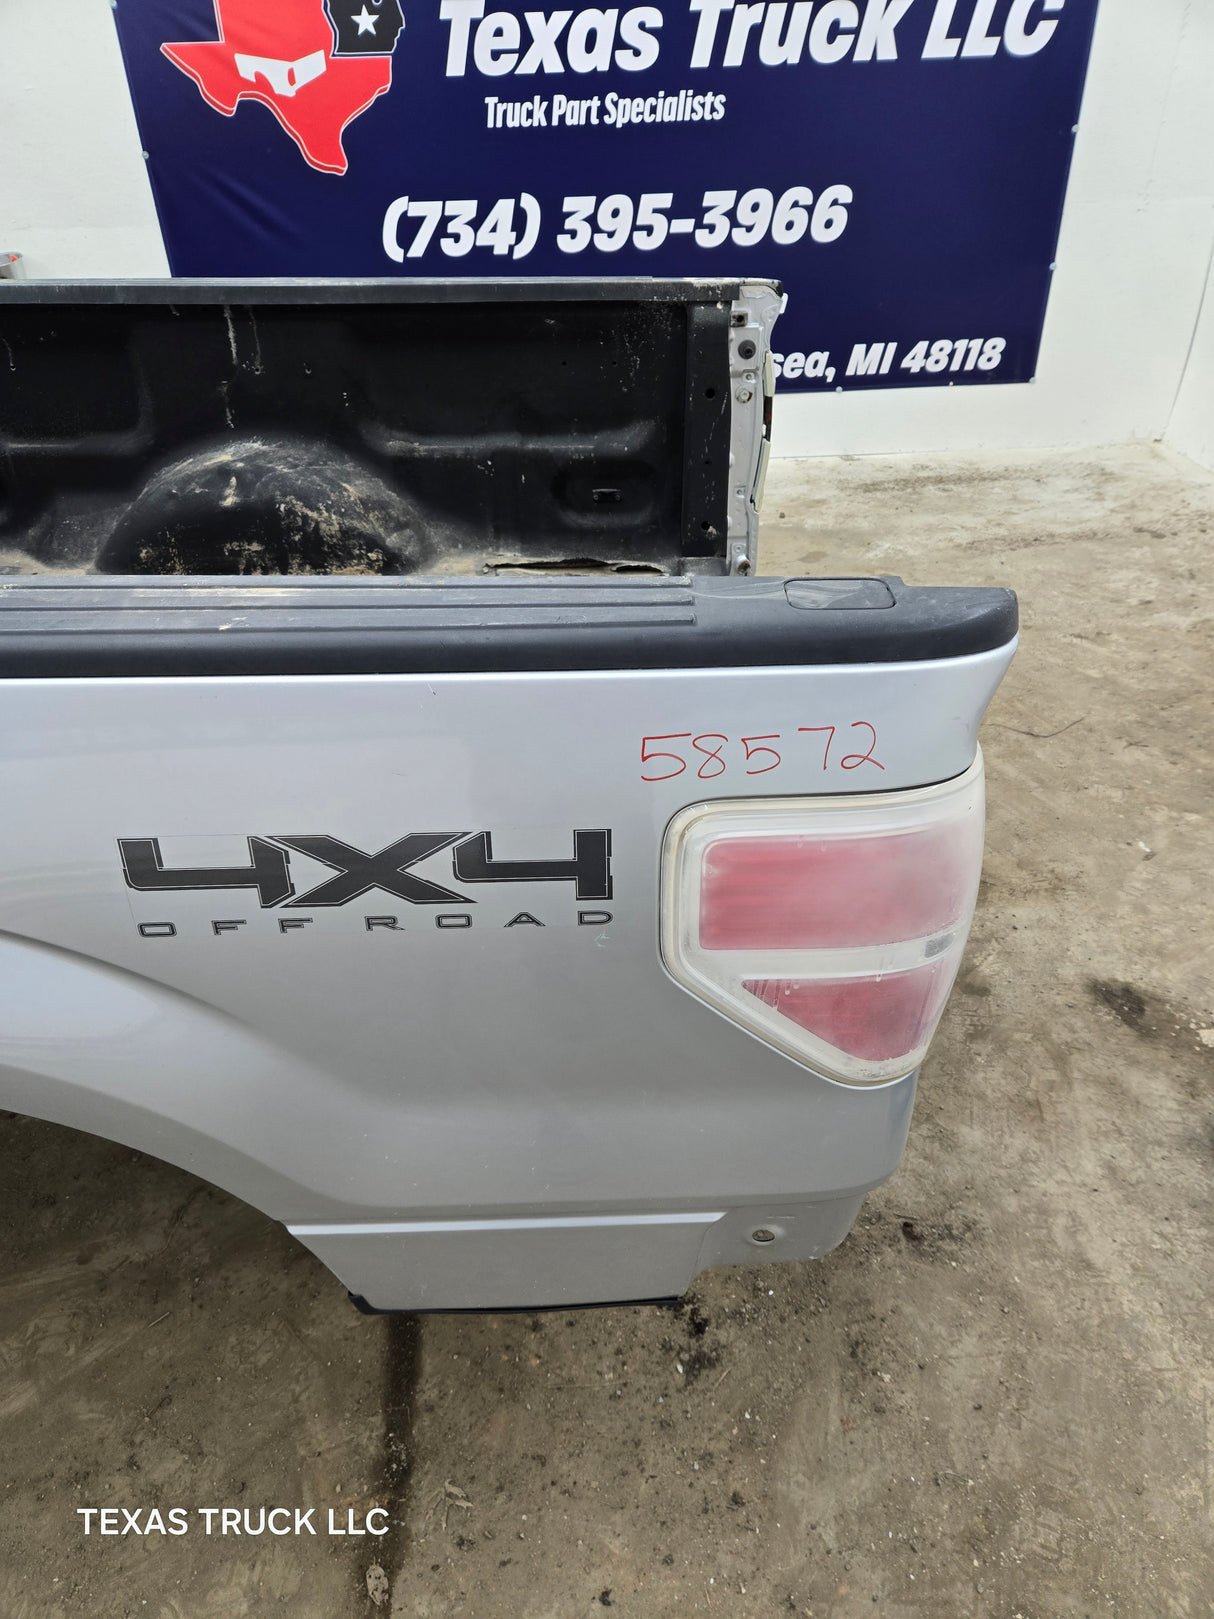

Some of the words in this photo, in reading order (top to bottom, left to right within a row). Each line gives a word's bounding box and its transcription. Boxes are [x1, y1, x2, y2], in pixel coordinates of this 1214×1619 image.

[440, 0, 664, 77] Texas
[689, 0, 914, 68] Truck
[921, 0, 1066, 59] LLC
[484, 95, 548, 129] Truck
[551, 94, 601, 127] Part
[603, 90, 727, 129] Specialists
[382, 192, 541, 263] (734)
[556, 184, 853, 255] 395-3966
[845, 342, 898, 376] MI
[900, 337, 1007, 373] 48118
[640, 721, 886, 782] 58572
